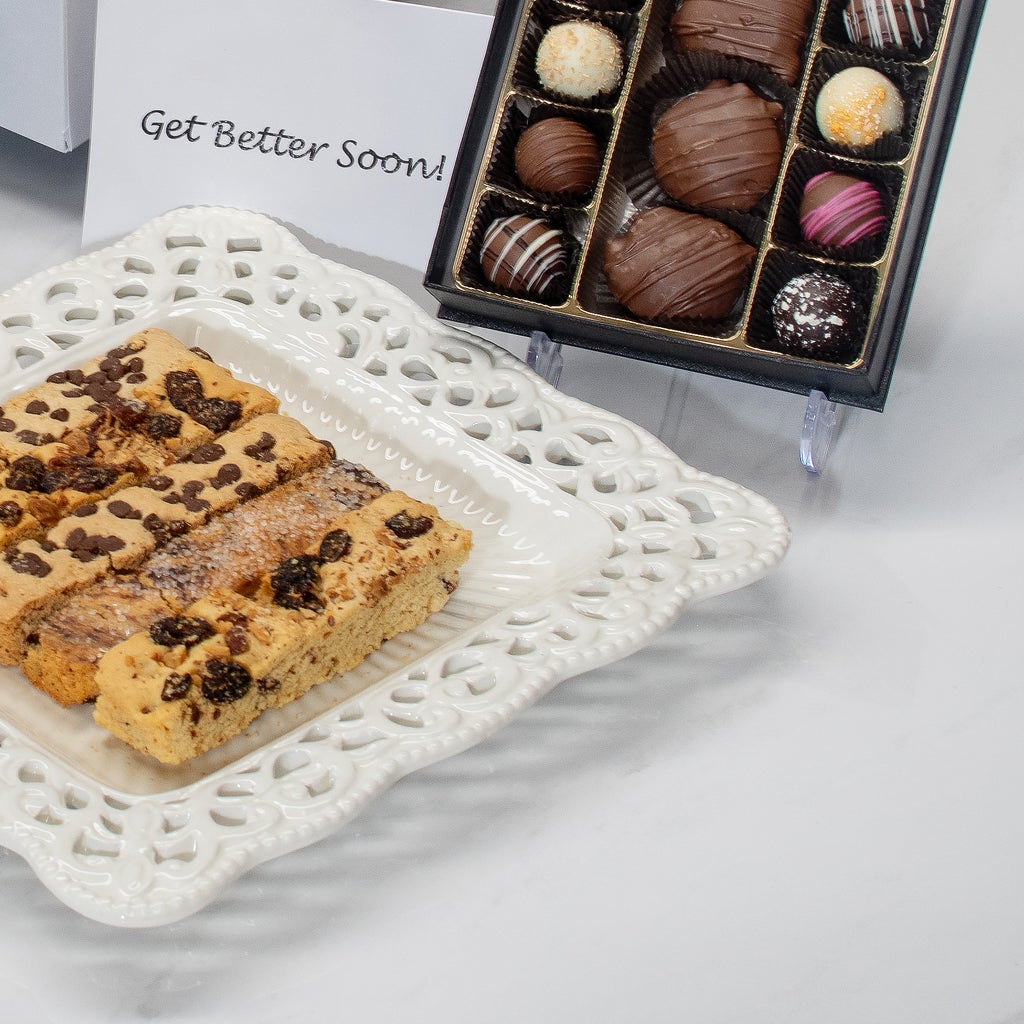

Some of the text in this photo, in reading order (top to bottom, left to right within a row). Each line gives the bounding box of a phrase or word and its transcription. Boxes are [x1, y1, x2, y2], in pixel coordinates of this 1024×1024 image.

[141, 109, 447, 181] Get Better Soon!
